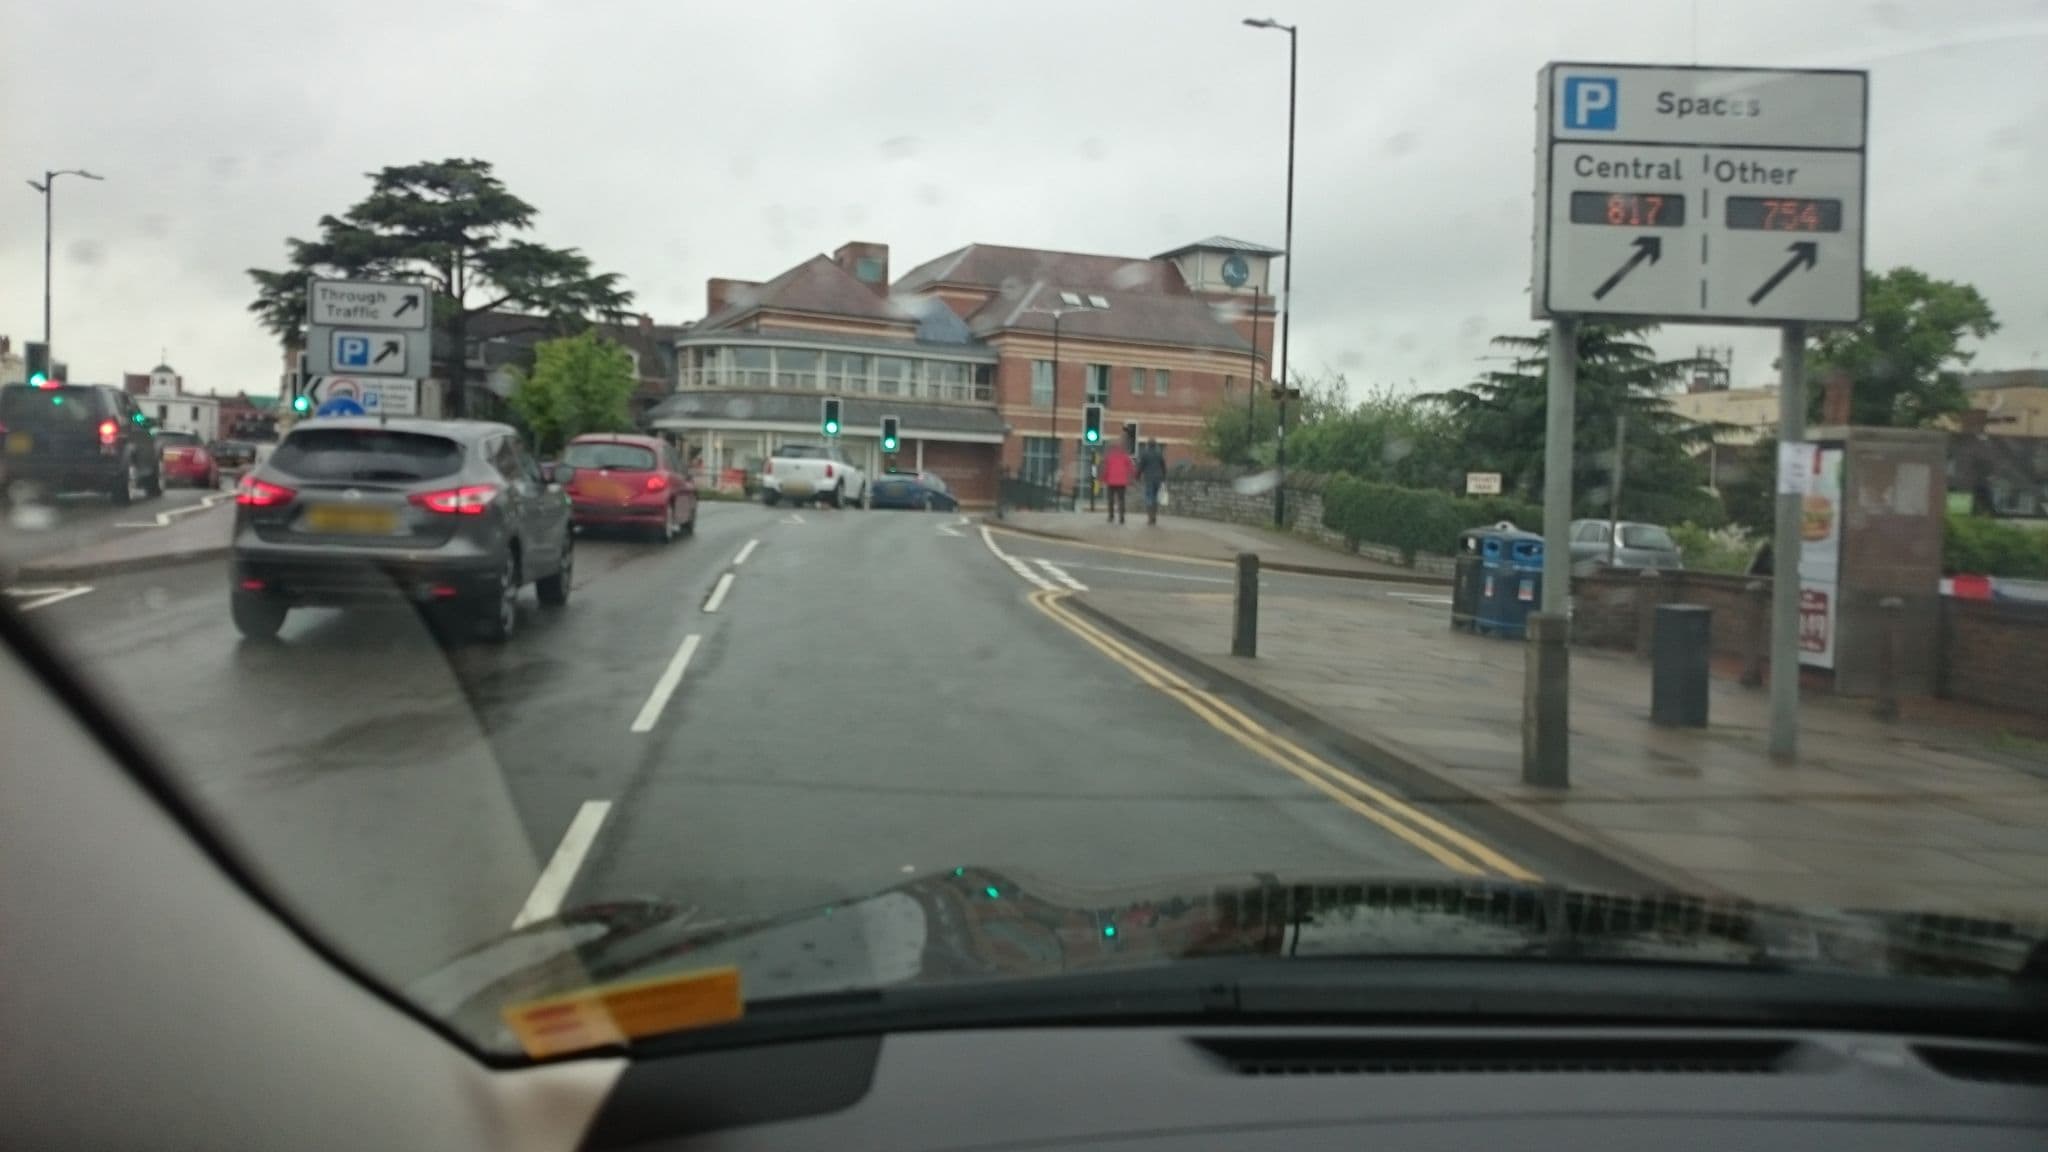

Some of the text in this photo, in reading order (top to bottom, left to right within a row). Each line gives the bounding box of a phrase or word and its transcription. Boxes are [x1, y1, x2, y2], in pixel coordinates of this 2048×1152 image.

[1576, 83, 1611, 125] P
[1574, 155, 1683, 180] Central
[1714, 160, 1799, 184] Other
[1607, 194, 1664, 226] 817
[1761, 200, 1818, 231] 754
[320, 288, 386, 305] Through
[326, 303, 379, 320] Traffic
[342, 339, 364, 364] P
